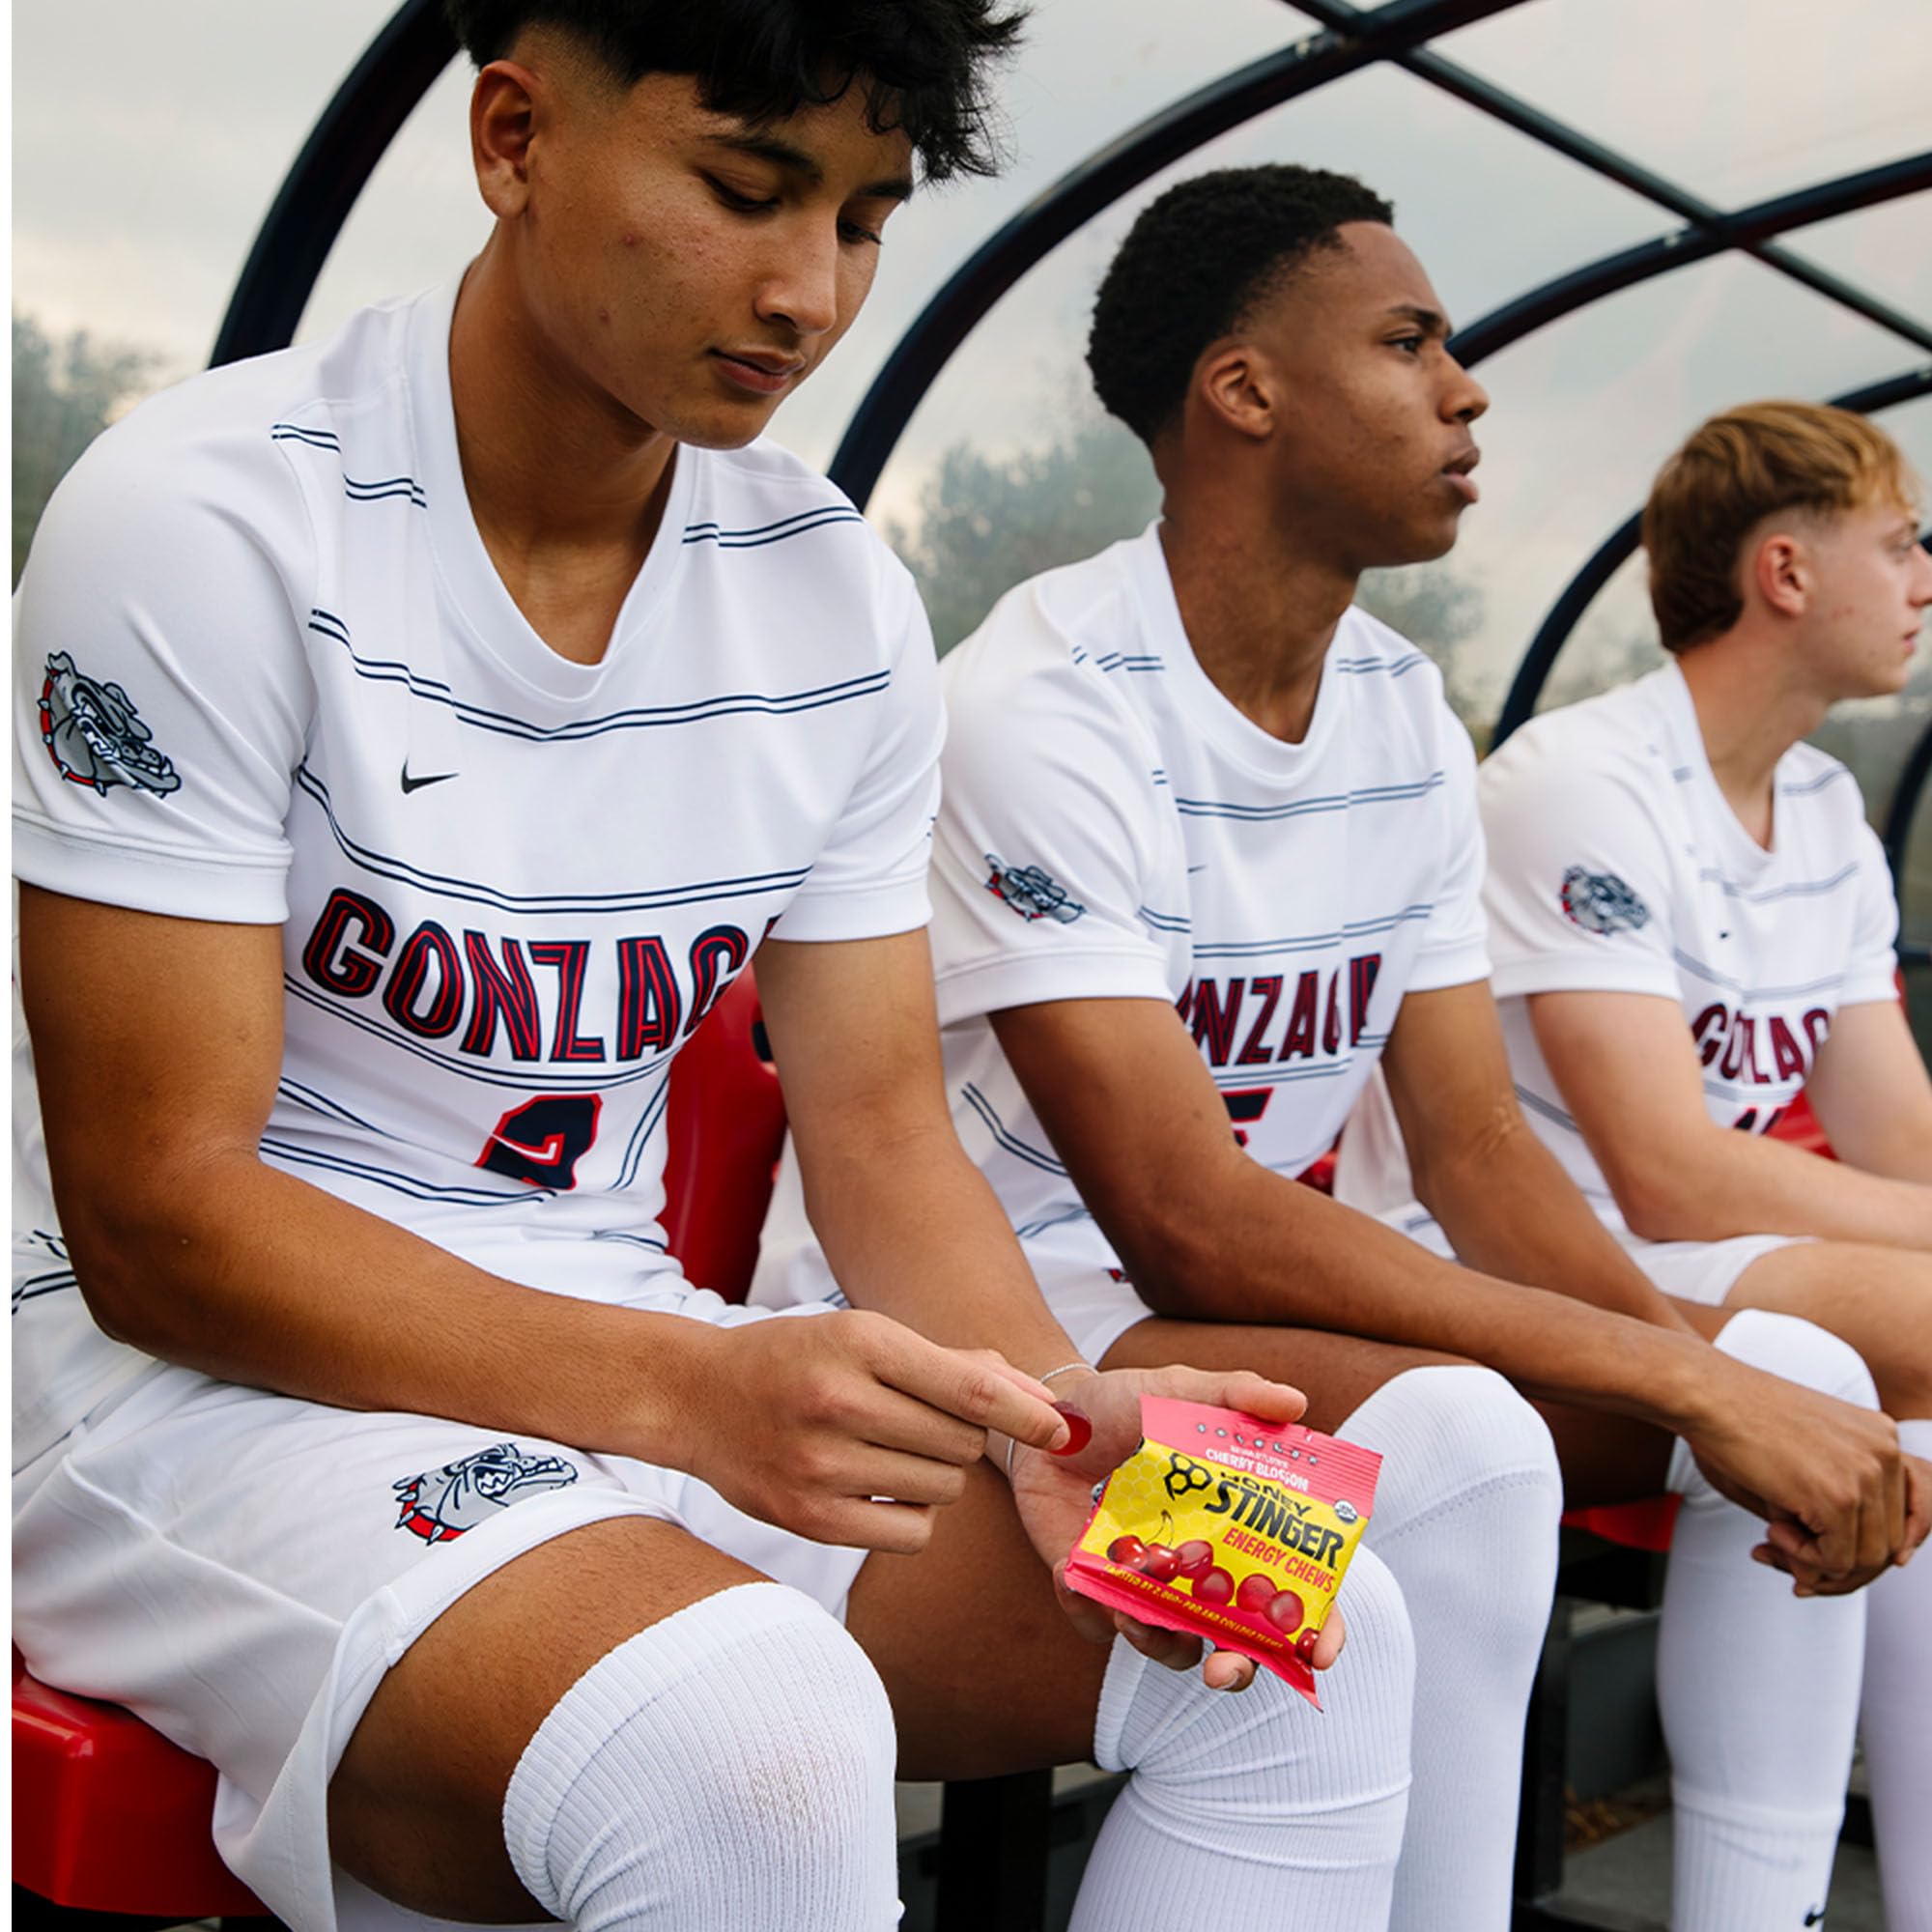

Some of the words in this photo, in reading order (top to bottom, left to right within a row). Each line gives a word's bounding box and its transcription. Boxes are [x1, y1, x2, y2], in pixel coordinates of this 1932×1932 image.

[302, 887, 781, 1064] GONZAG
[1256, 1462, 1309, 1492] BLOSSOM
[1204, 1480, 1344, 1569] STINGER
[1222, 1527, 1287, 1567] ENERGY
[1284, 1556, 1335, 1593] CHEWS
